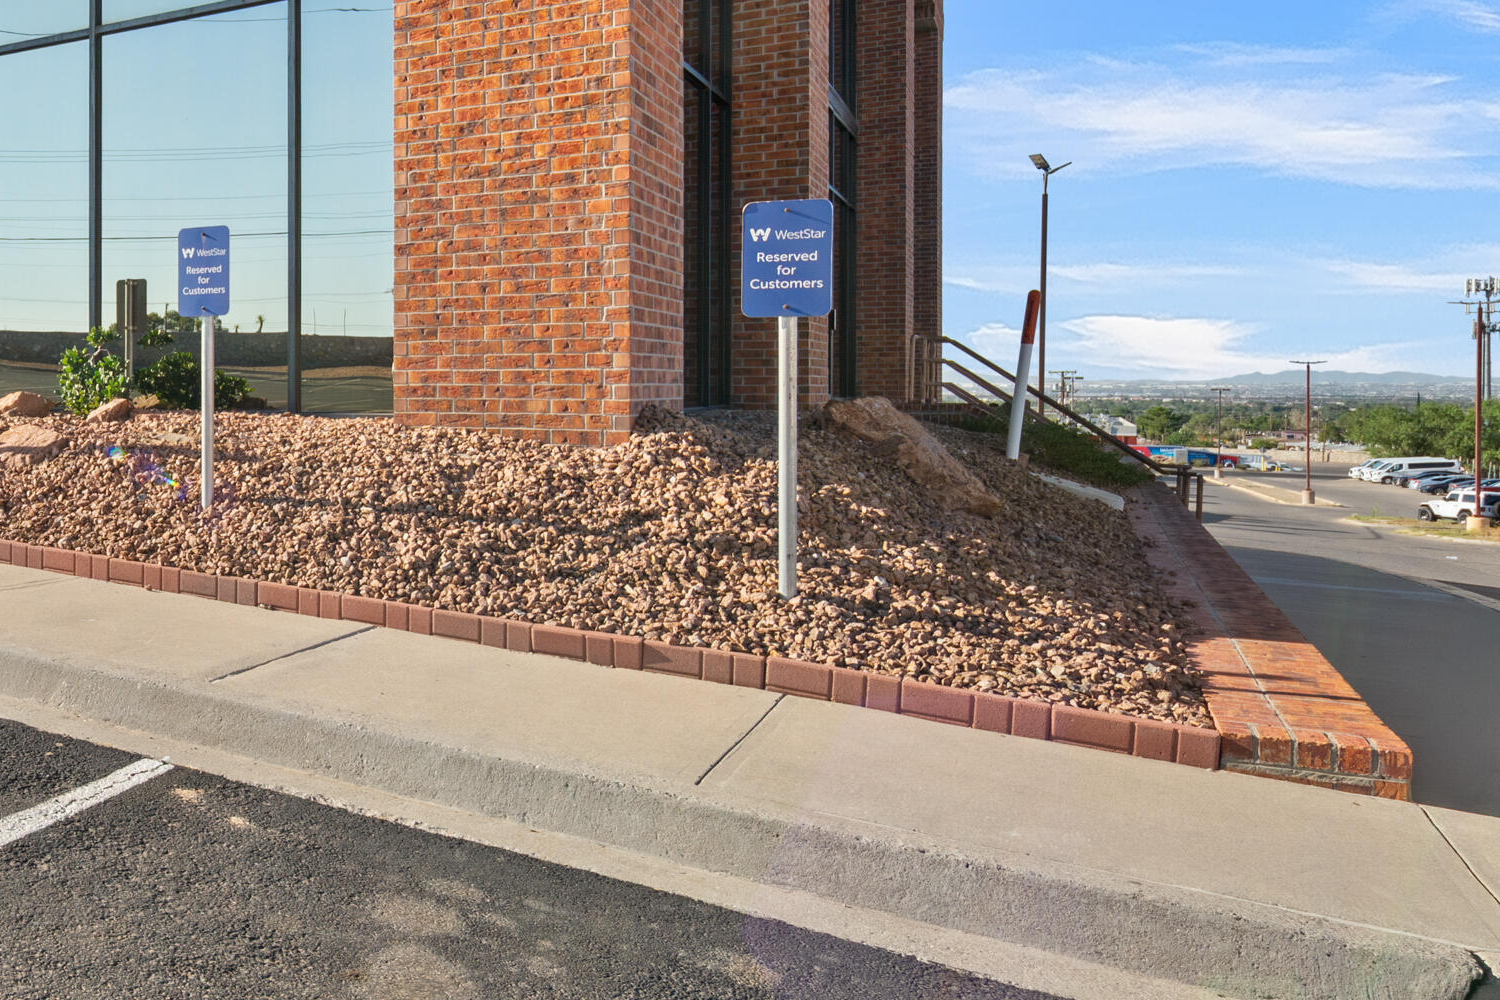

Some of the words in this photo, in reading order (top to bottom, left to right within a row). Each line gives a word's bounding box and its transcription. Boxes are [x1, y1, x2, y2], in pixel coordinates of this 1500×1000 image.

[775, 228, 827, 241] WestStar
[196, 247, 227, 257] WestStar
[756, 250, 819, 263] Reserved
[186, 264, 223, 275] Reserved
[777, 265, 797, 275] for
[197, 276, 210, 284] for
[749, 279, 825, 290] Customers
[182, 286, 226, 296] Customers
